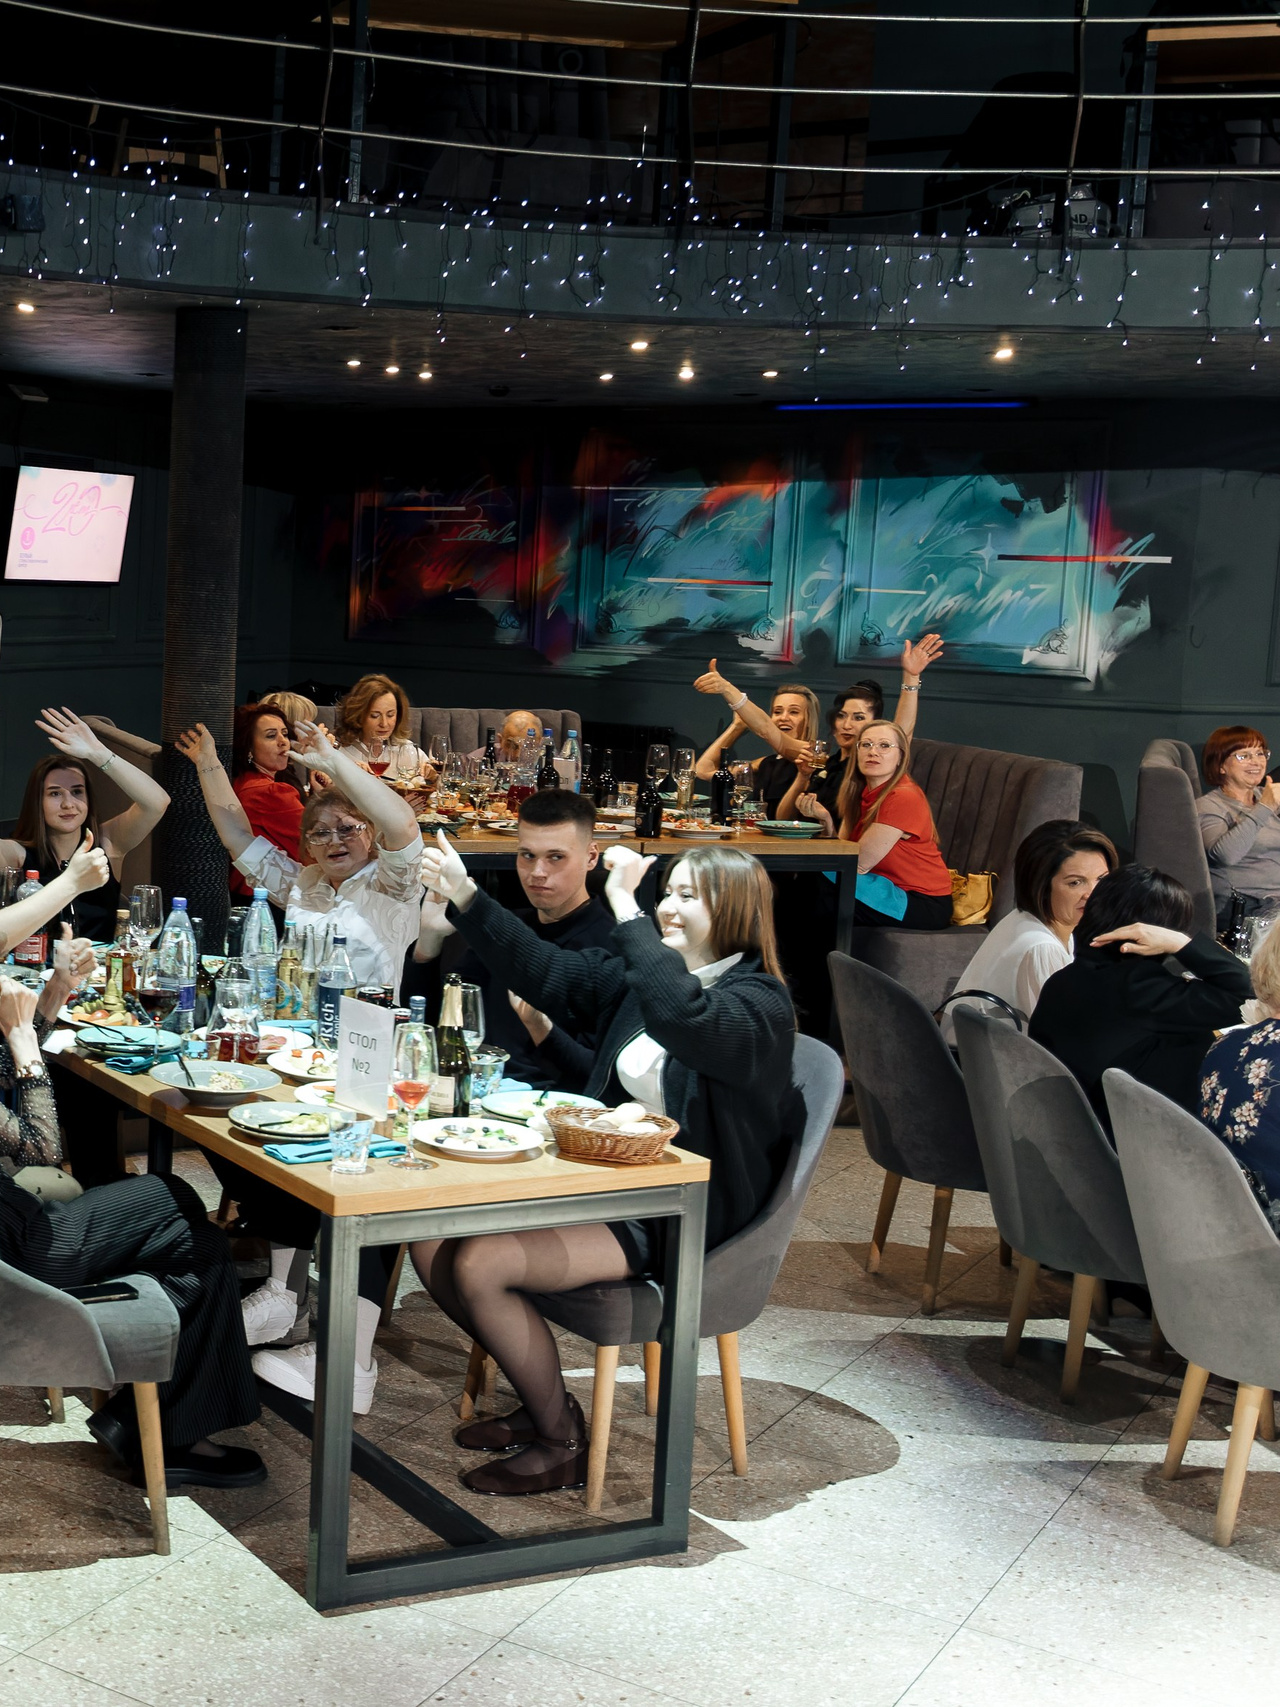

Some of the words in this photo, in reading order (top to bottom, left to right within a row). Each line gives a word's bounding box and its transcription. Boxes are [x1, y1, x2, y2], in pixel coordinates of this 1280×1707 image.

[320, 1003, 335, 1040] Rich
[348, 1031, 377, 1051] СТОЛ
[351, 1057, 371, 1075] №2
